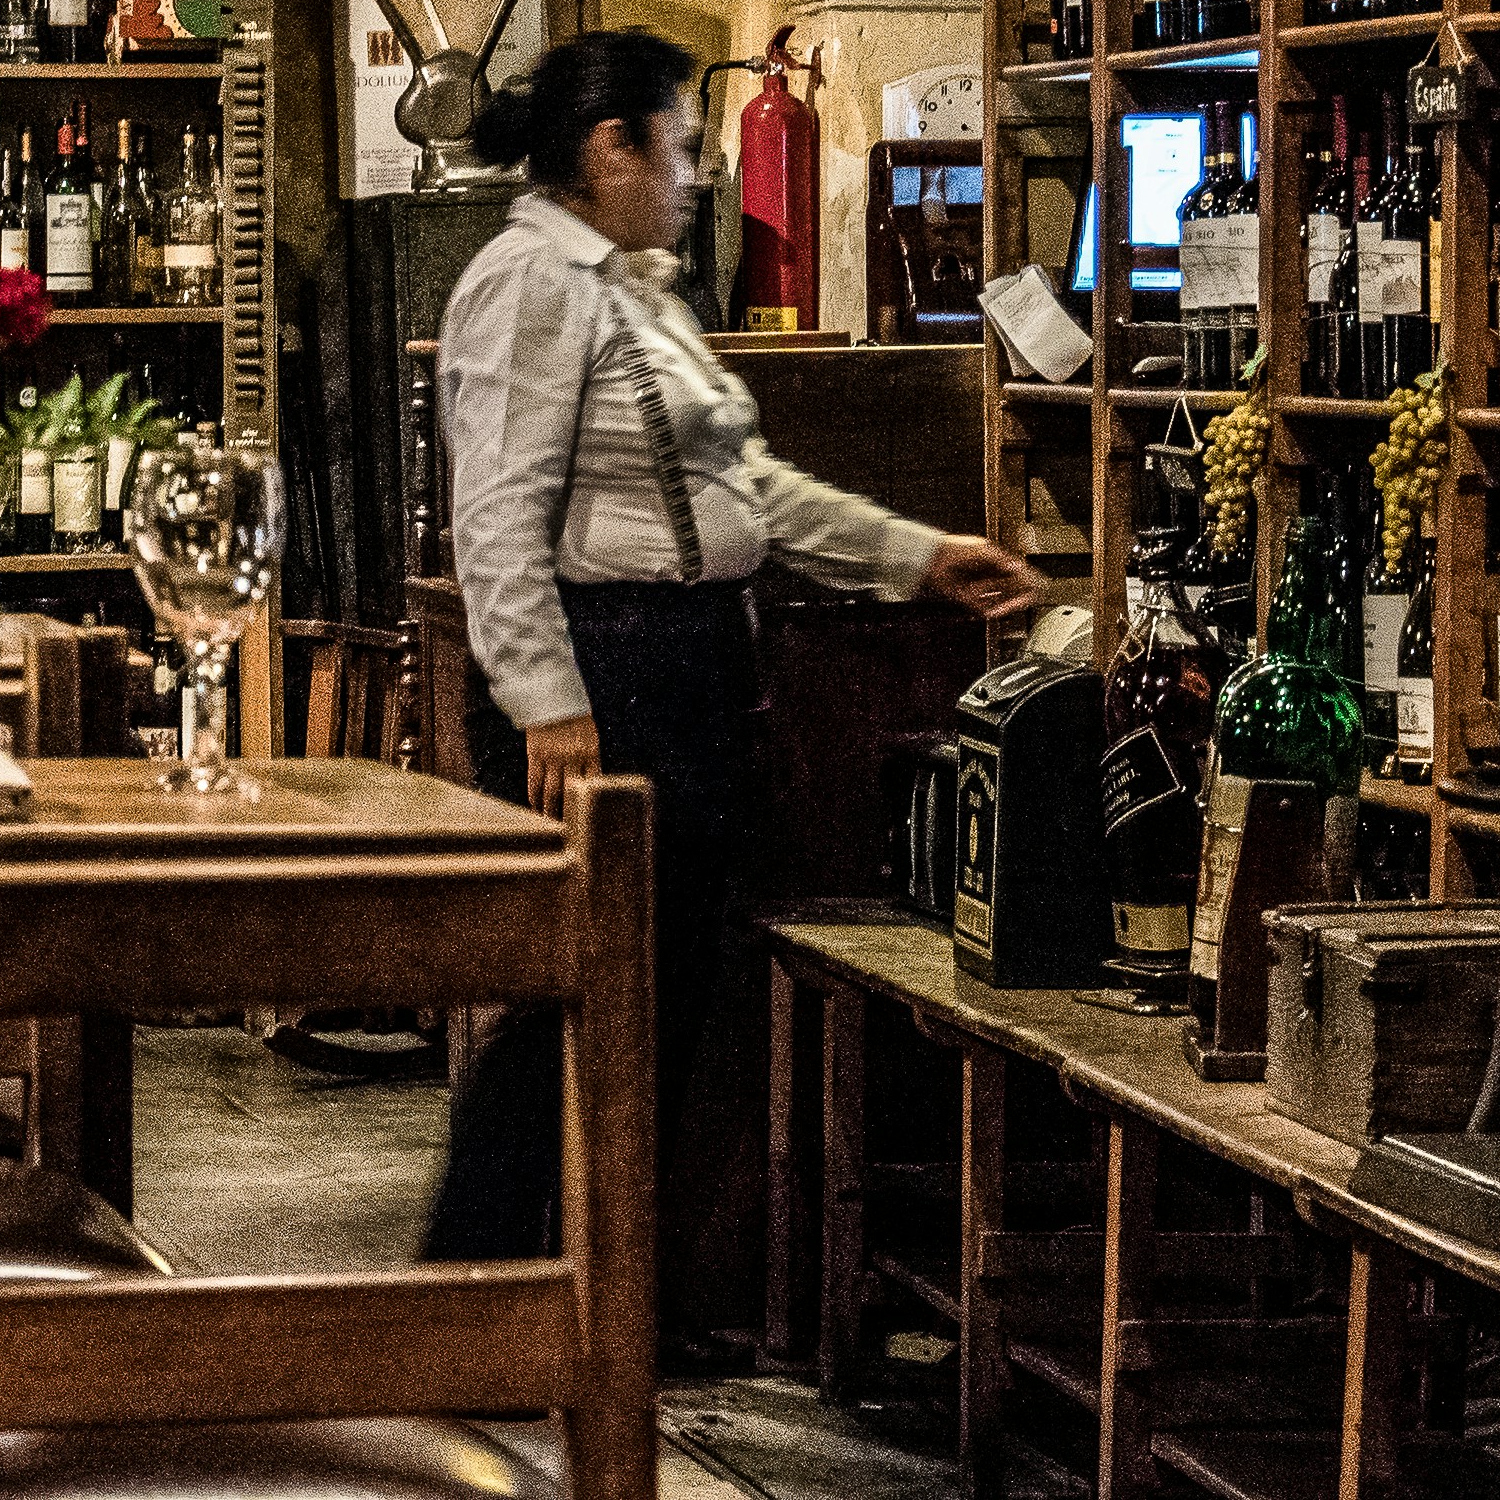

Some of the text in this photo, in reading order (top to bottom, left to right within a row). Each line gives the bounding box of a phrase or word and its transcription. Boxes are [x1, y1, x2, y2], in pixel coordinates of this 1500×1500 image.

[960, 79, 972, 91] 12
[1415, 76, 1457, 118] España
[923, 99, 937, 113] 10
[918, 120, 928, 133] 9
